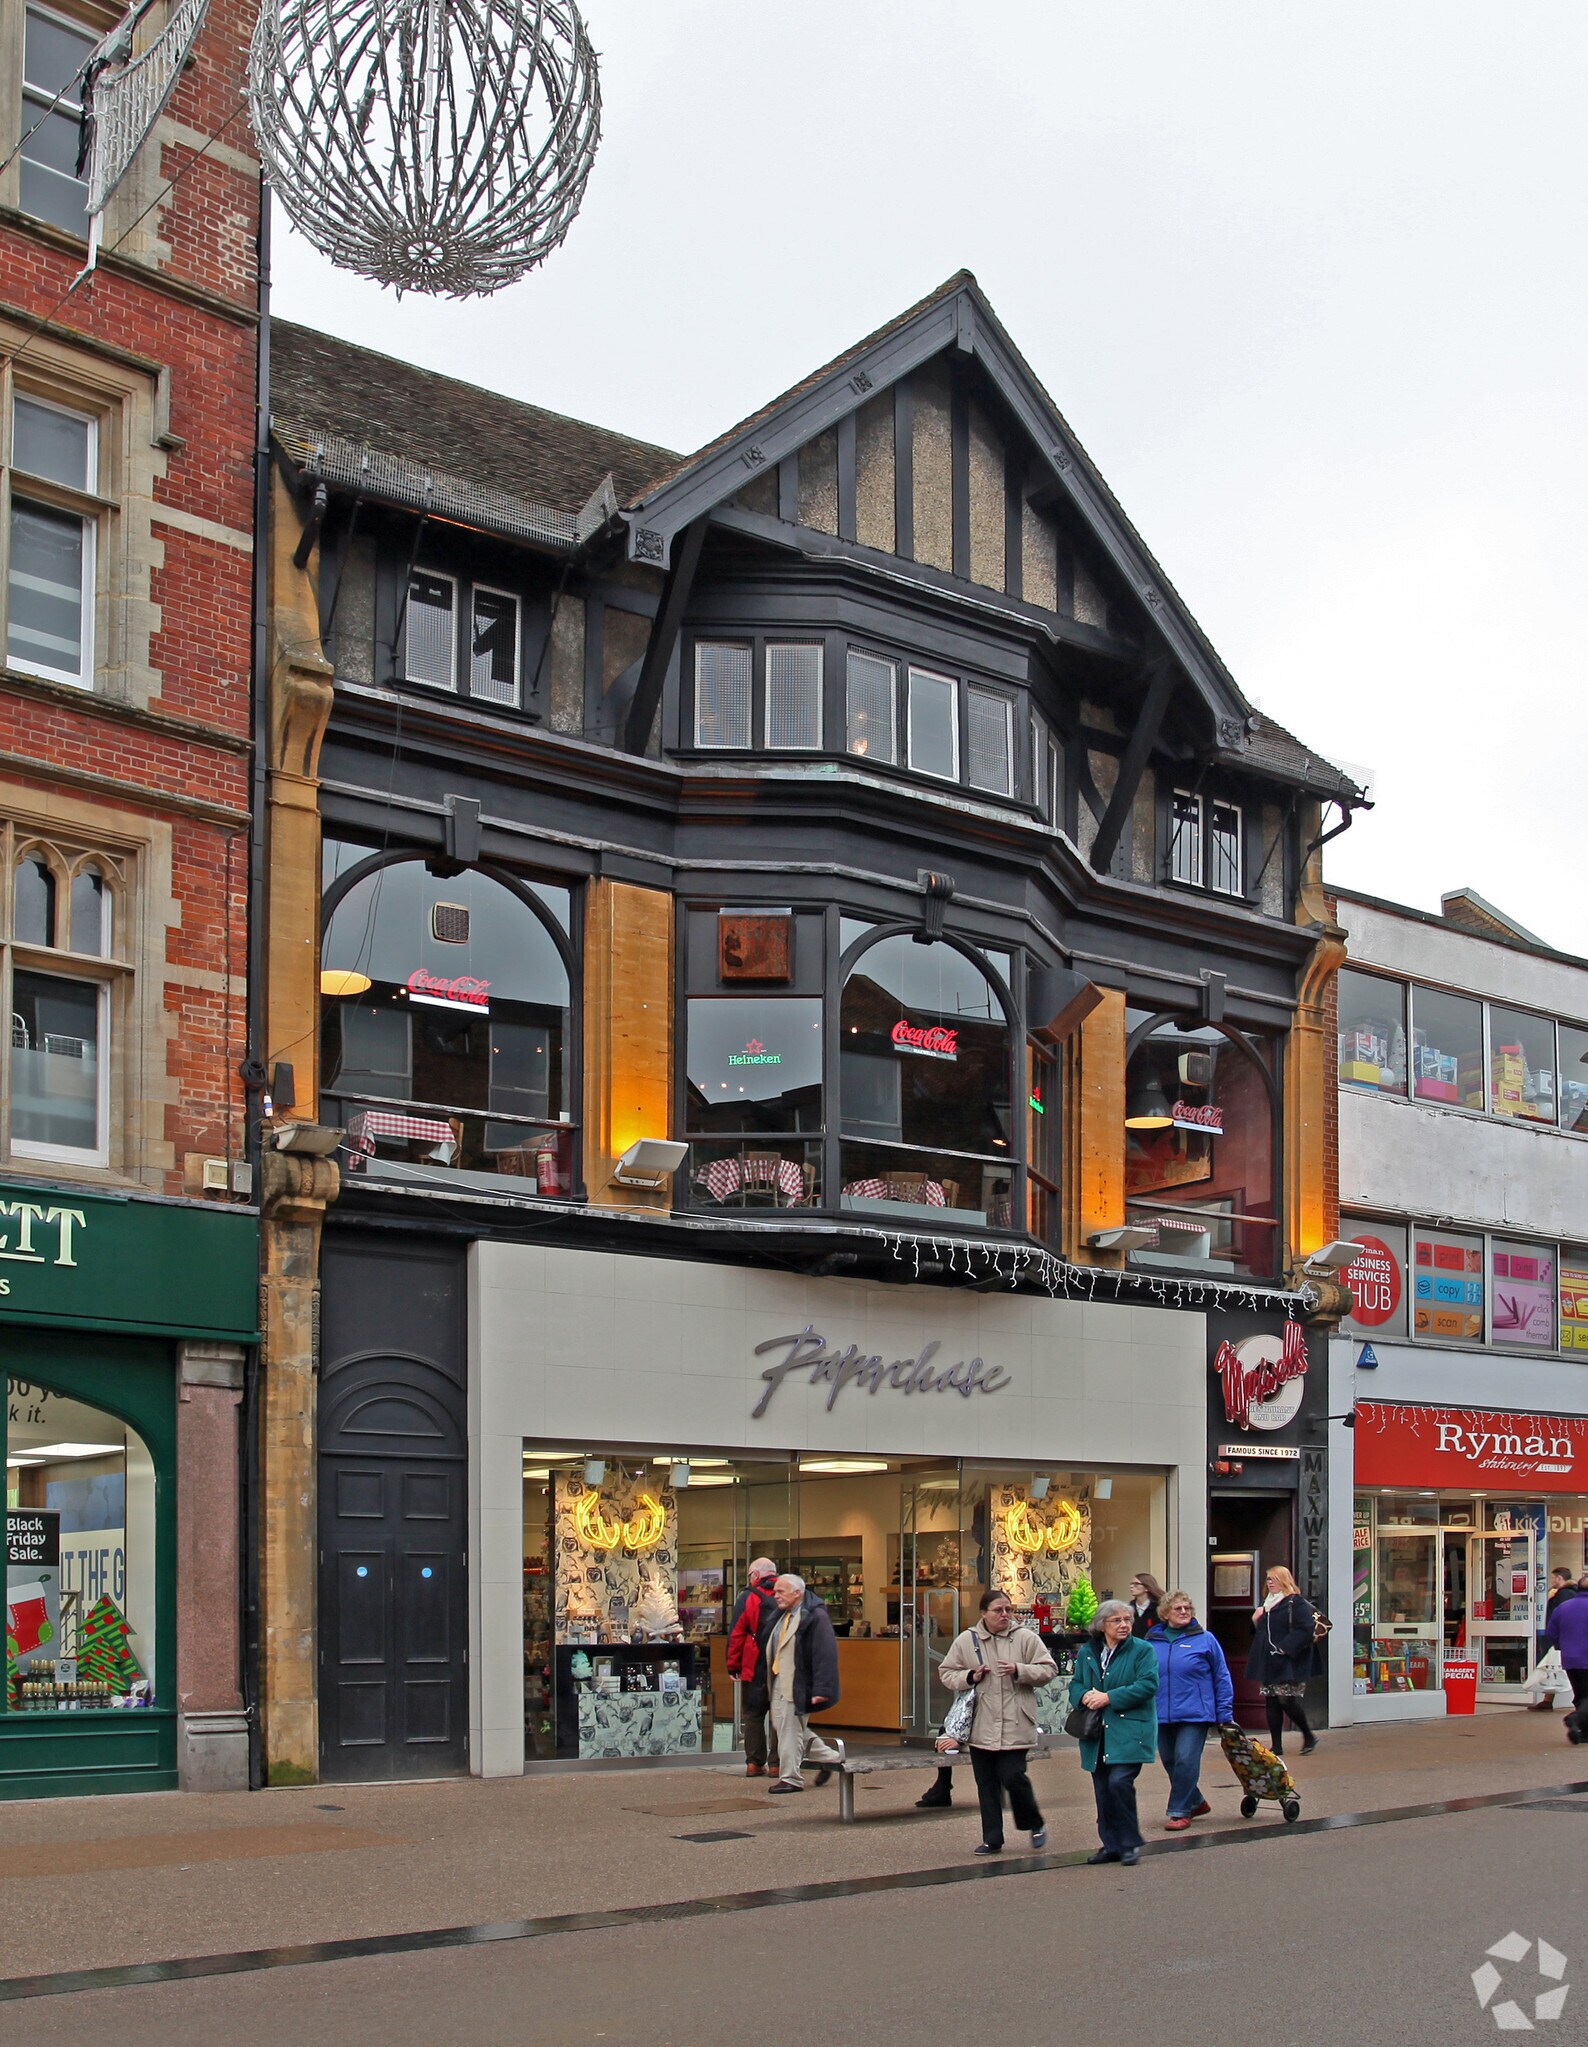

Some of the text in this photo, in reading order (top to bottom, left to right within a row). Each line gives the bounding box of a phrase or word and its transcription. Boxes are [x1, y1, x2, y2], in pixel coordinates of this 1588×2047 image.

[728, 1054, 781, 1066] Heineken
[0, 1201, 87, 1267] TT
[1360, 1247, 1385, 1256] yman
[1347, 1269, 1391, 1284] SERVICES
[1347, 1281, 1392, 1311] HUB
[1438, 1285, 1461, 1299] copy
[1437, 1318, 1458, 1329] scan
[1532, 1318, 1550, 1328] comb
[1525, 1329, 1550, 1340] thermal
[1577, 1334, 1588, 1343] se
[754, 1324, 1013, 1418] Paperchase
[27, 1404, 46, 1424] it.
[1434, 1423, 1575, 1460] Ryman
[1227, 1446, 1299, 1458] FAMOUS SINCE 1972
[1478, 1455, 1539, 1478] stationery
[7, 1517, 44, 1531] Black
[7, 1533, 46, 1546] Friday
[1353, 1528, 1368, 1539] ALF
[1353, 1537, 1369, 1548] RICE
[9, 1547, 43, 1561] Sale.
